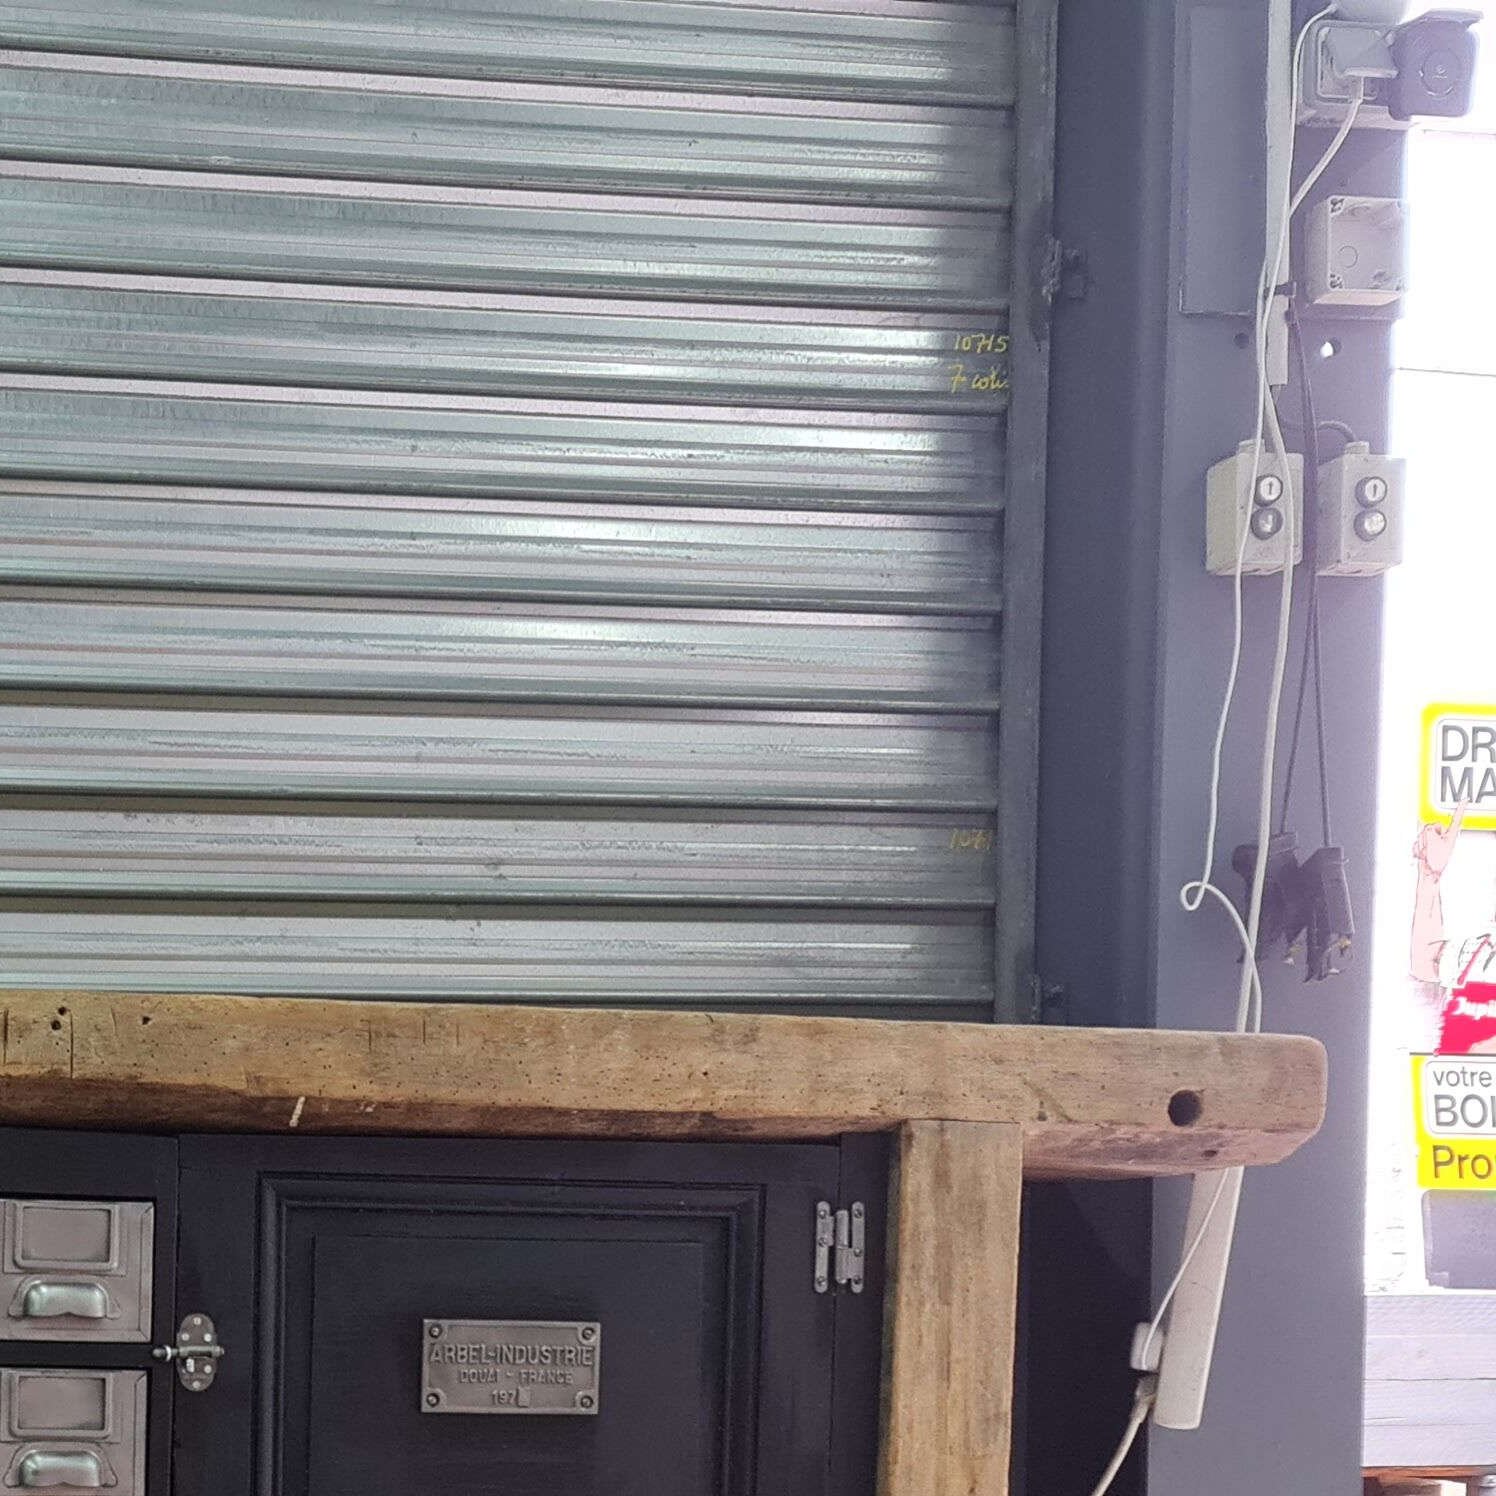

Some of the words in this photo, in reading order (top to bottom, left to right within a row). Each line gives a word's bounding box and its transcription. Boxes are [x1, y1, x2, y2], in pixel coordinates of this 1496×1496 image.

[1433, 1066, 1492, 1088] votre
[1432, 1144, 1496, 1179] Pro
[429, 1343, 593, 1366] ARBEL-INDUSTRIE
[460, 1369, 500, 1384] DOUAI
[519, 1369, 574, 1385] FRANCE
